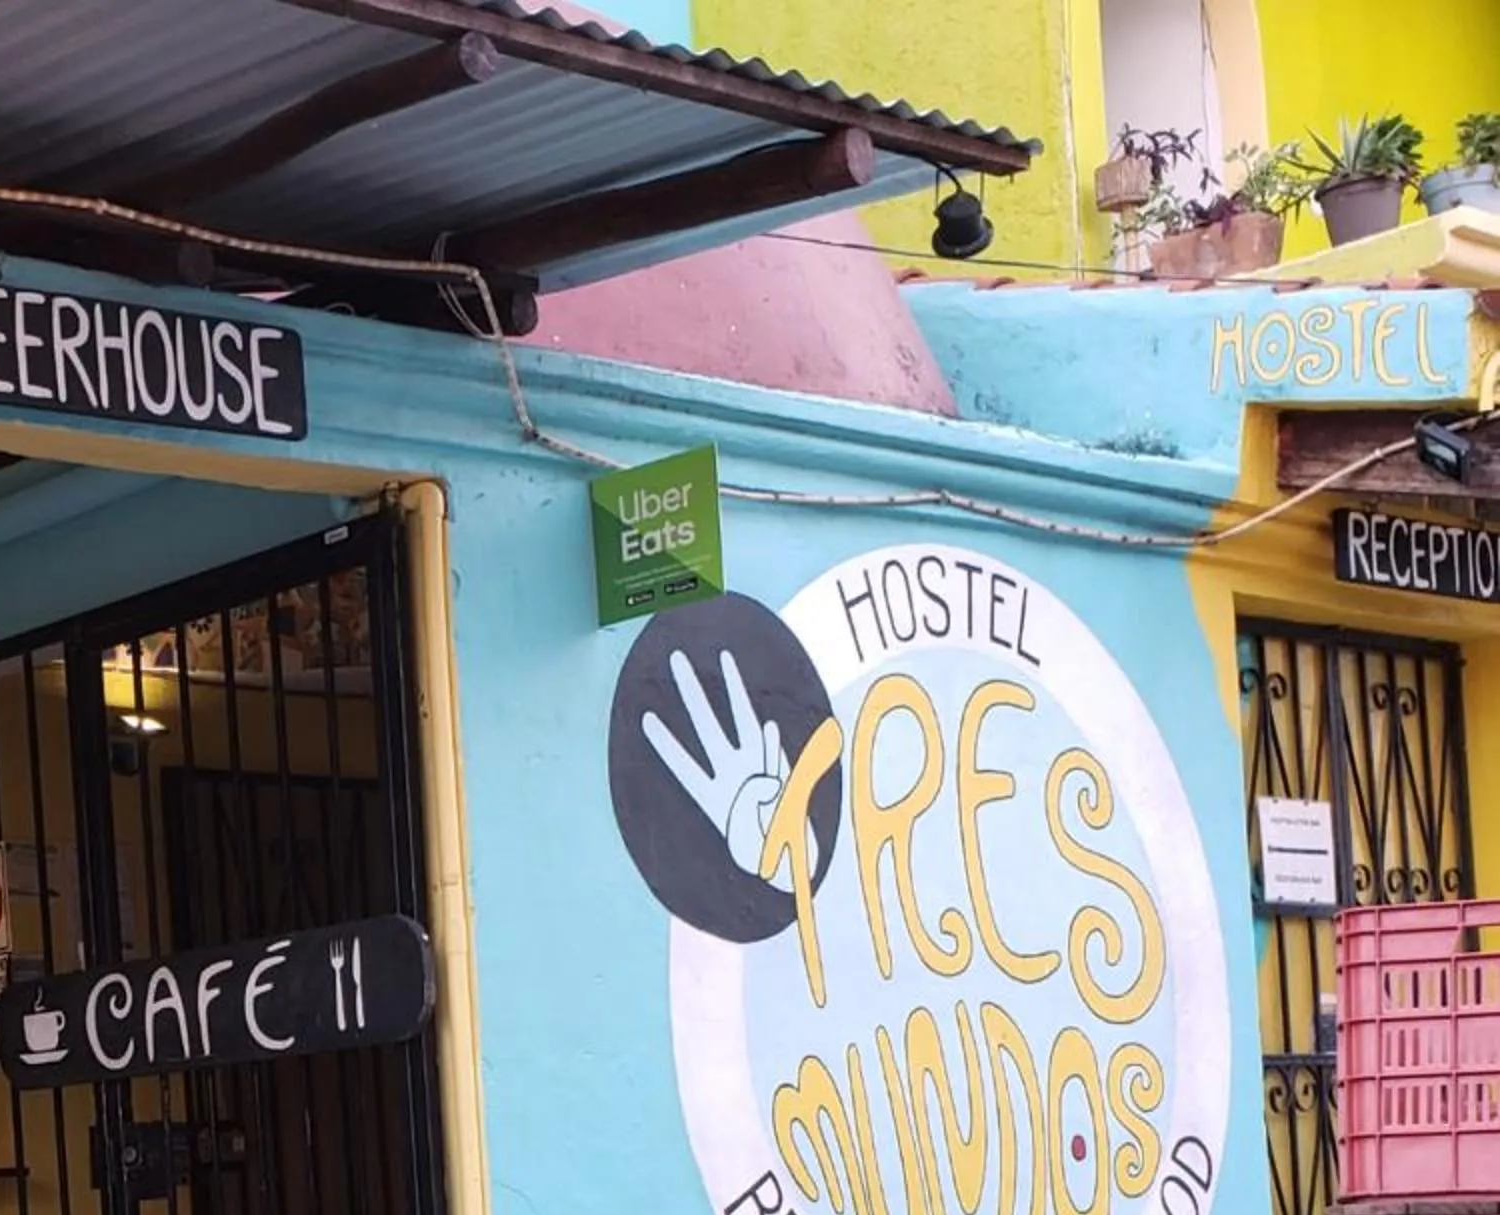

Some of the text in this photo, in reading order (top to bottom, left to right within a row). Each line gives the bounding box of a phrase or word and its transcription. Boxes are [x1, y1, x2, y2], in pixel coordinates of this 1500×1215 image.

[1210, 297, 1448, 394] HOSTEL
[619, 482, 693, 525] Uber
[620, 519, 696, 564] Eats
[836, 554, 1041, 667] HOSTEL
[759, 672, 1167, 1024] TRES
